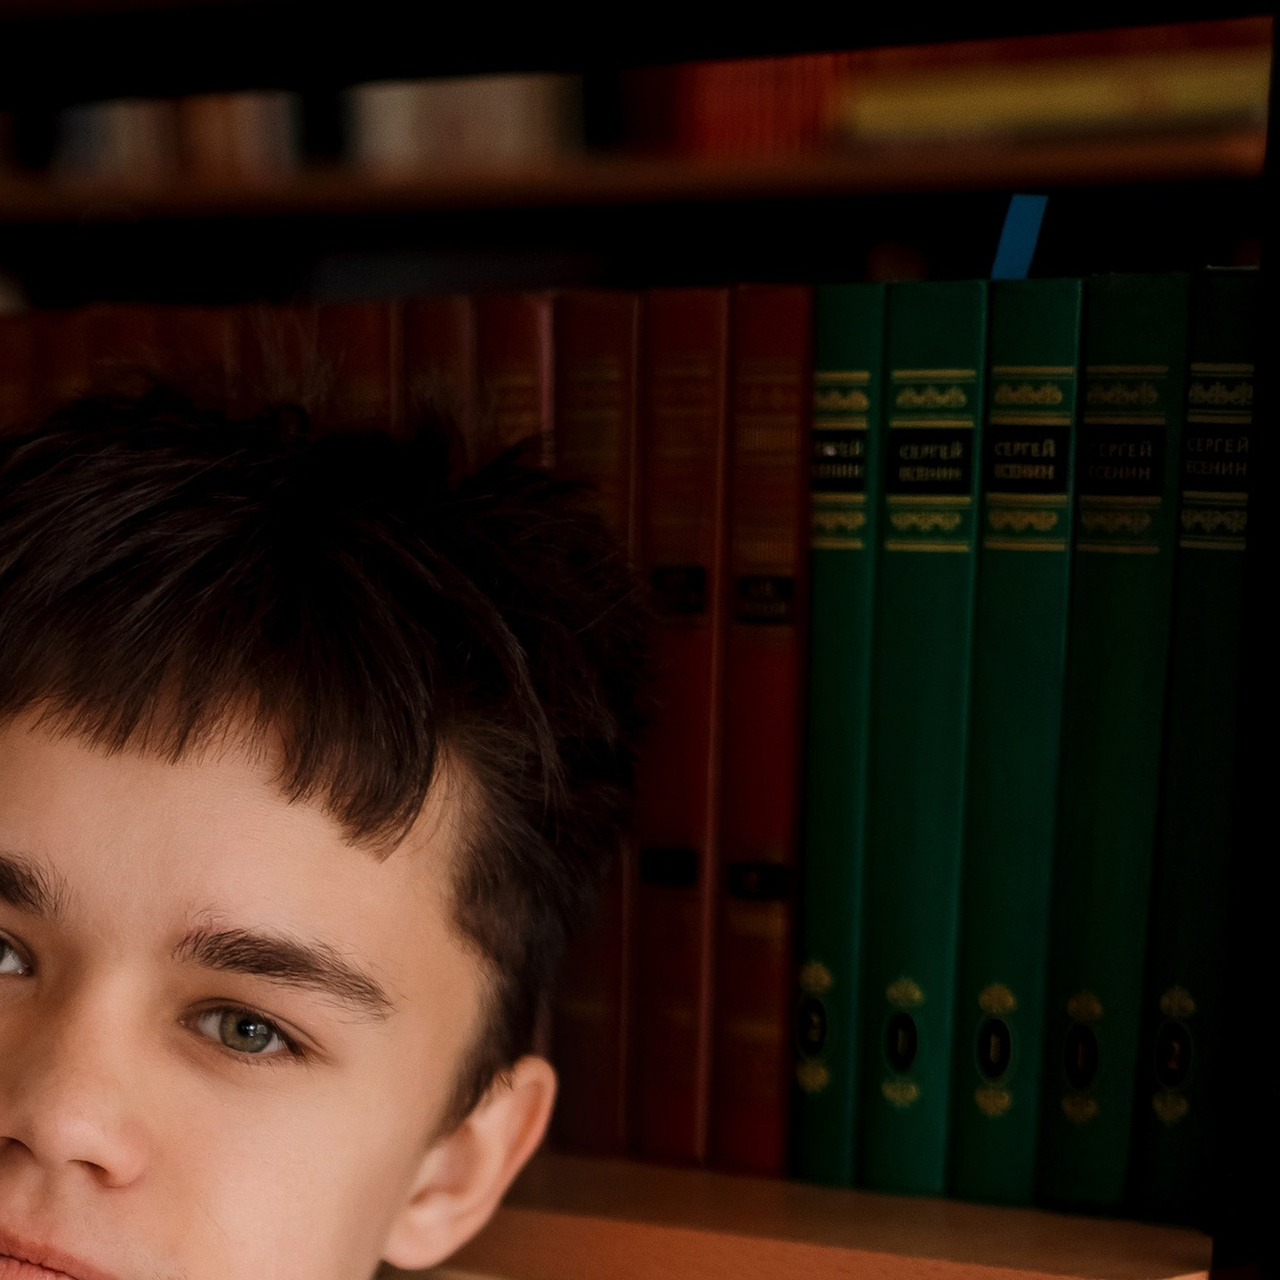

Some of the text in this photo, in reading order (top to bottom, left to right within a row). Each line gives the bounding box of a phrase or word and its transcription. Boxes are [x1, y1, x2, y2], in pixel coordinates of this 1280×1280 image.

[994, 437, 1056, 459] СЕРГЕЙ
[1090, 439, 1153, 458] СЕРГЕЙ
[1187, 435, 1250, 454] СЕРГЕЙ
[1185, 459, 1249, 477] ЕСЕНИН
